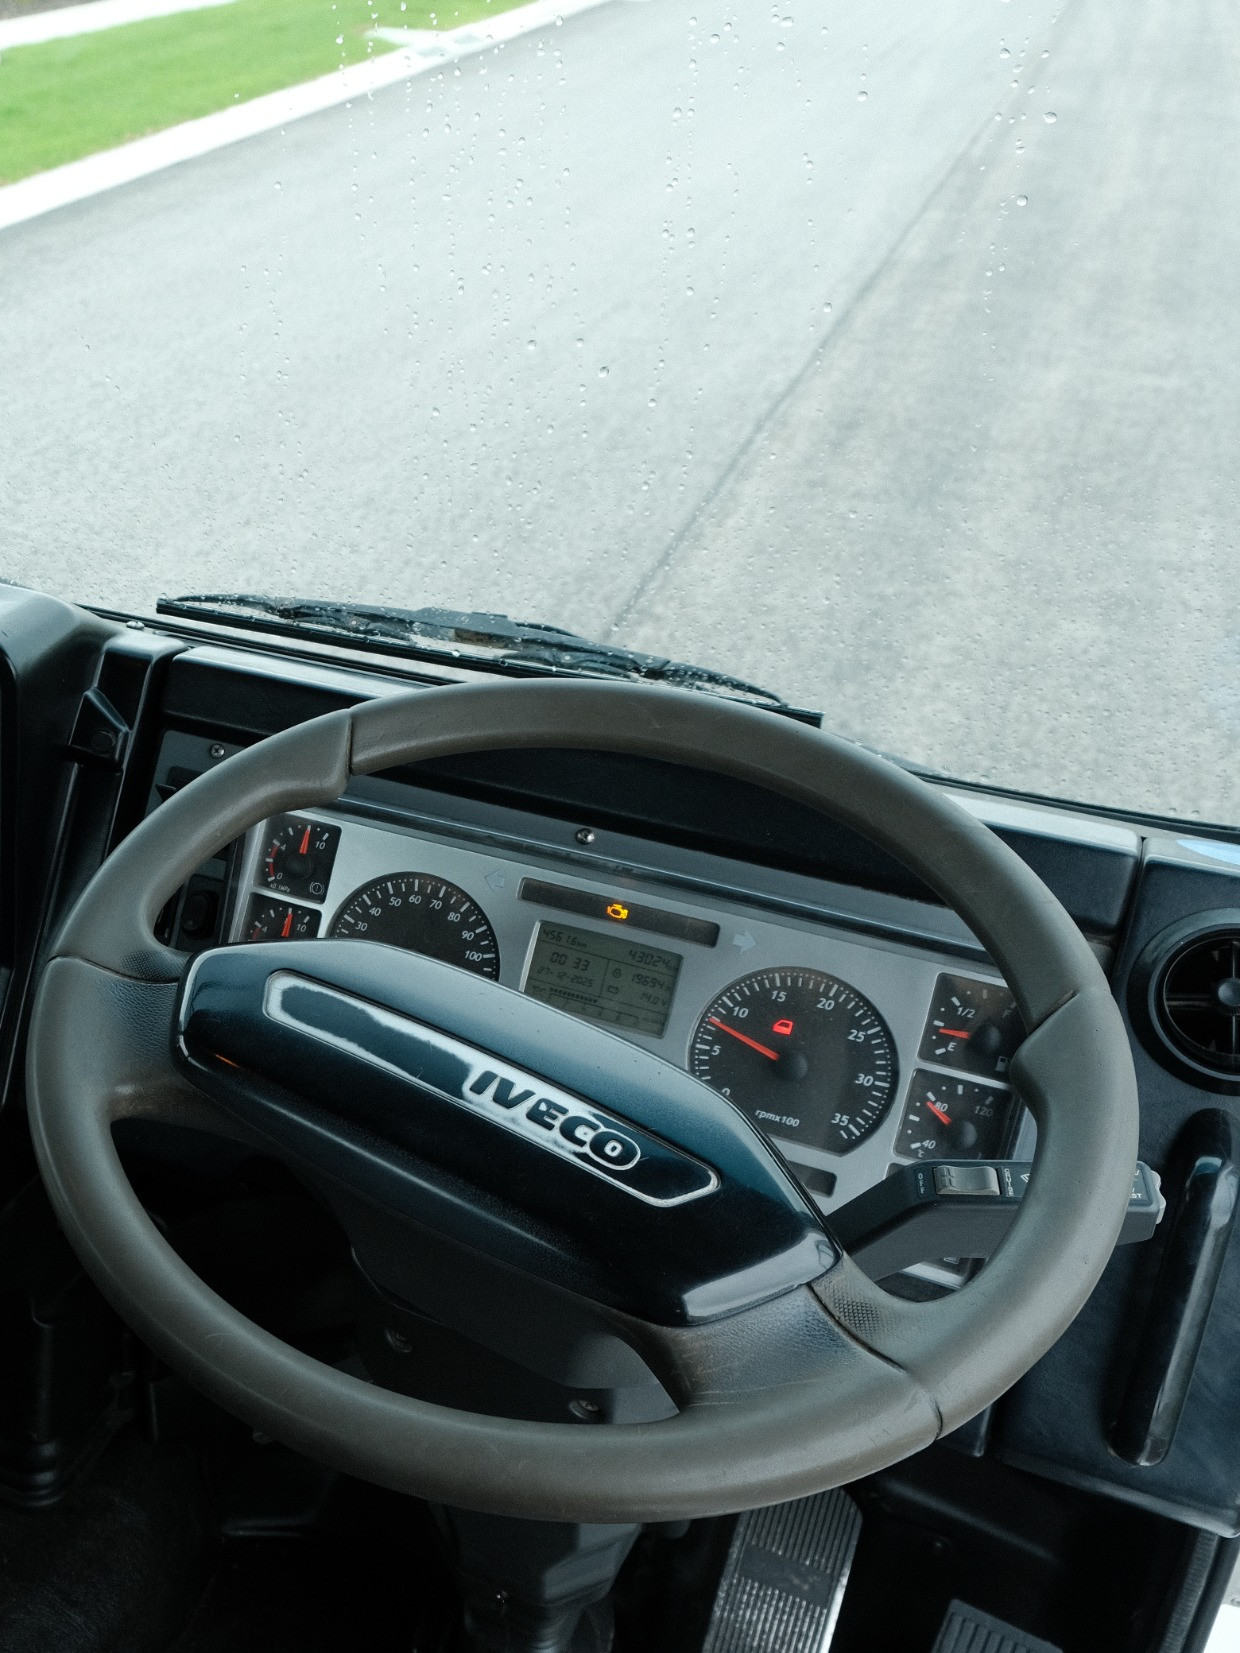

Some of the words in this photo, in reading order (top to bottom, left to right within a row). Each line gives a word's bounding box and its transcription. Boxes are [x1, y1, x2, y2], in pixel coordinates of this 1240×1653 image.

[280, 843, 287, 852] 4
[315, 841, 326, 850] 10
[276, 872, 283, 880] 0
[388, 896, 402, 907] 50
[408, 894, 422, 905] 60
[429, 899, 443, 910] 70
[368, 907, 382, 917] 40
[447, 911, 461, 922] 80
[261, 924, 268, 933] 4
[296, 923, 307, 933] 10
[355, 921, 368, 932] 30
[461, 930, 475, 941] 90
[464, 950, 483, 962] 100
[770, 990, 787, 1002] 15
[816, 997, 835, 1011] 20
[732, 1006, 749, 1019] 10
[956, 1006, 976, 1019] 1/2
[847, 1029, 866, 1043] 25
[711, 1045, 721, 1056] 5
[947, 1042, 957, 1052] E
[854, 1072, 874, 1087] 30
[934, 1101, 948, 1112] 80
[974, 1105, 994, 1117] 120
[469, 1070, 640, 1169] IVECO
[754, 1109, 800, 1128] rpmx100
[831, 1112, 850, 1127] 35
[922, 1139, 937, 1150] 40
